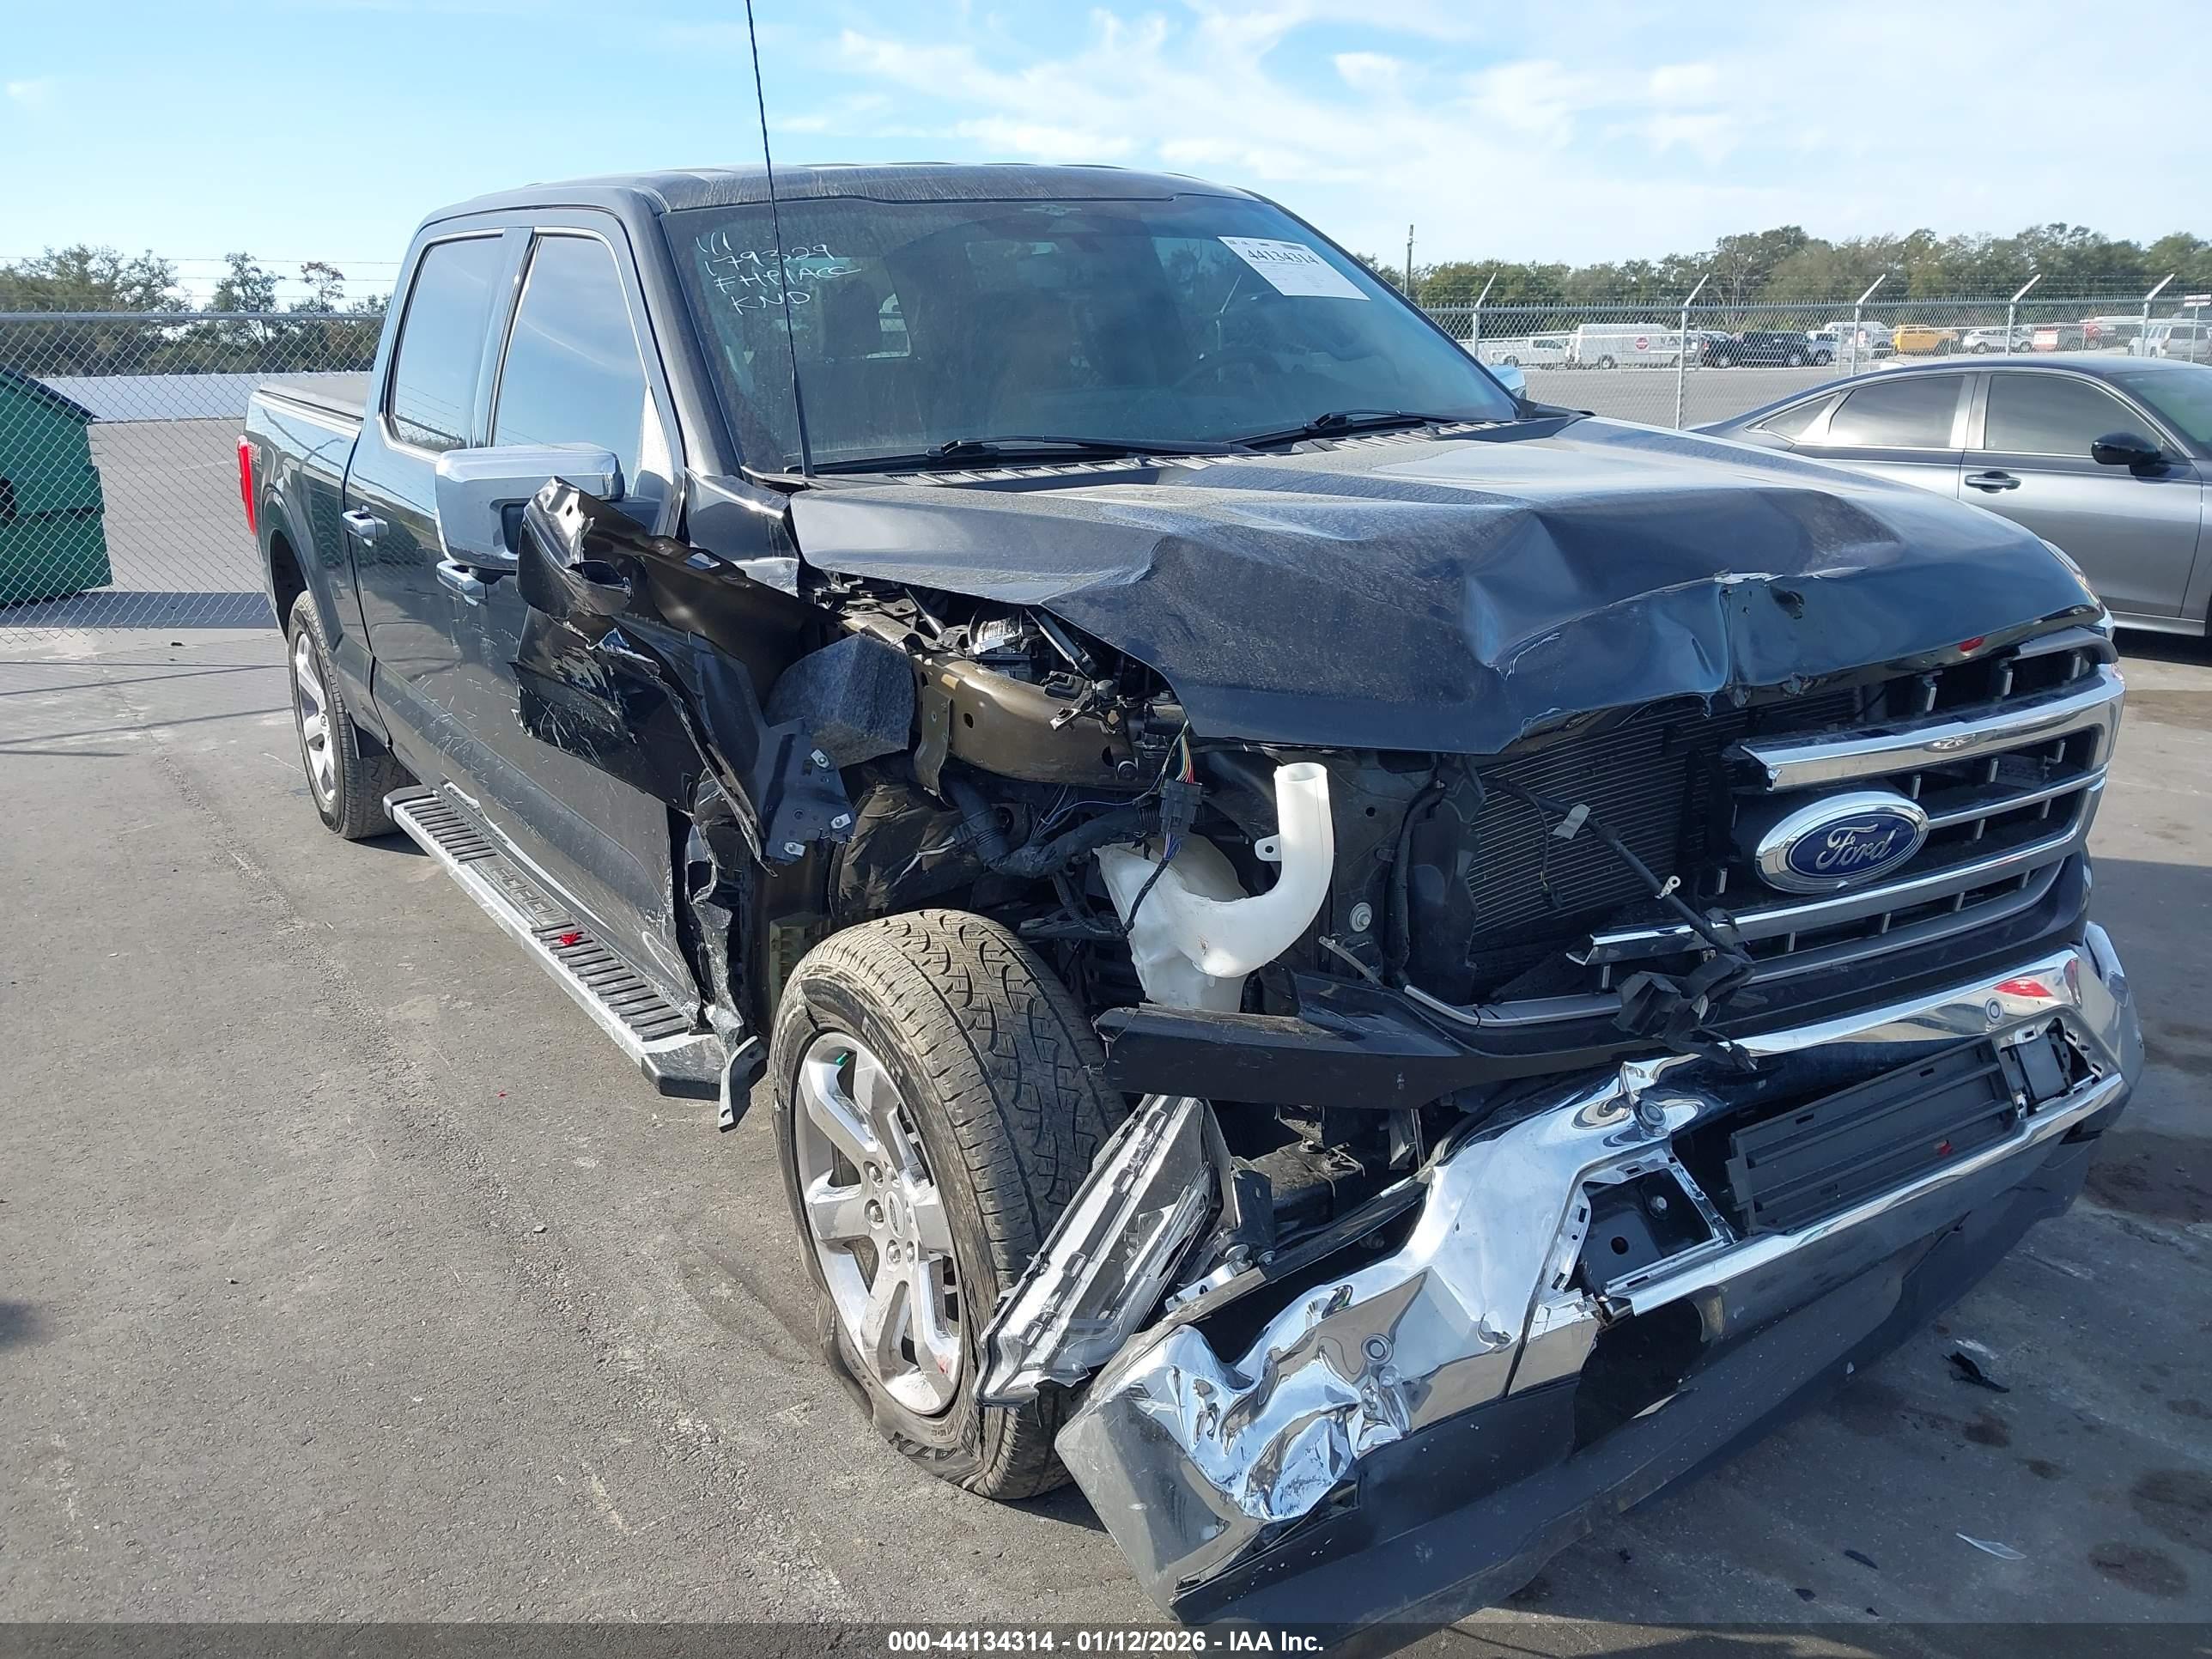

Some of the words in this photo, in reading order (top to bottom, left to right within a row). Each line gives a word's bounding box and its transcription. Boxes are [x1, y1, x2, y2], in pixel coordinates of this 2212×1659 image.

[1247, 248, 1320, 265] 44134314
[1815, 823, 1898, 871] Ford
[489, 867, 554, 914] FORD
